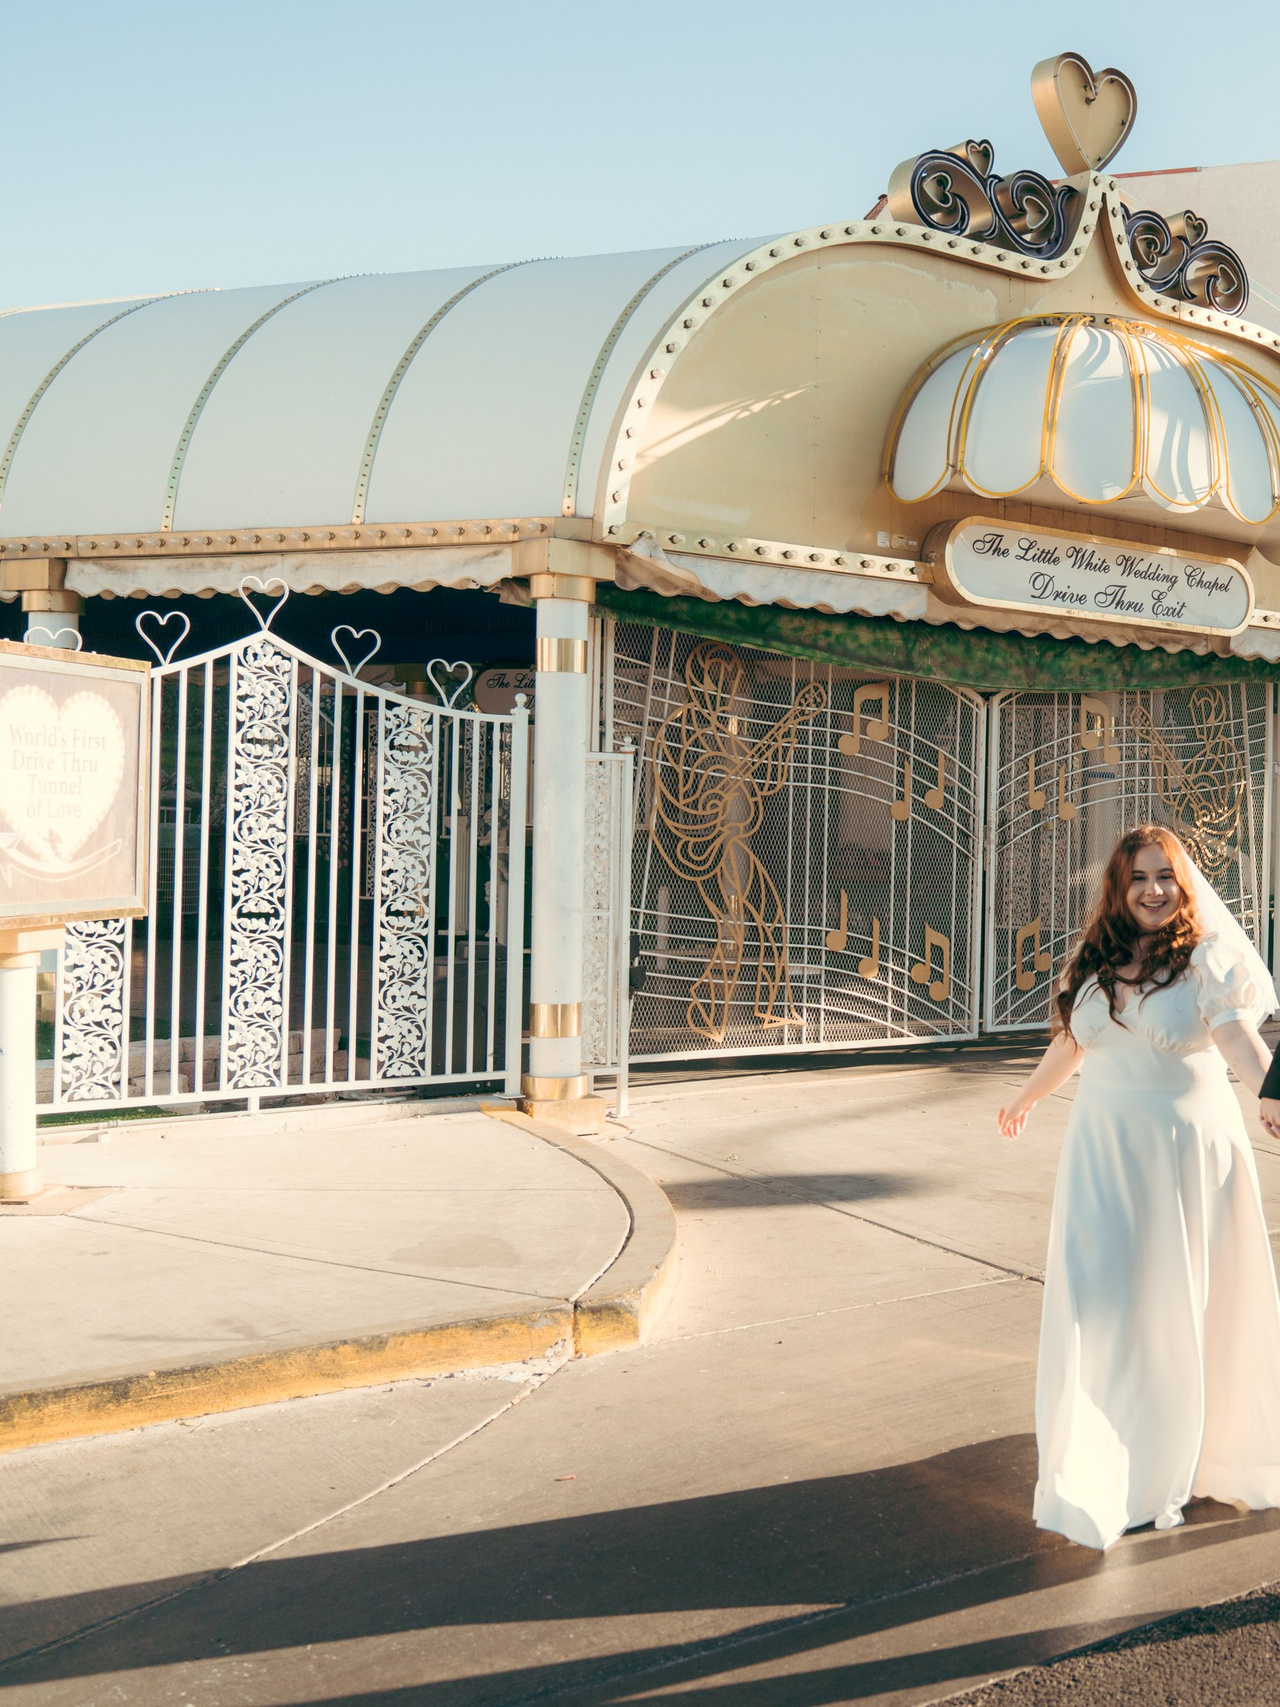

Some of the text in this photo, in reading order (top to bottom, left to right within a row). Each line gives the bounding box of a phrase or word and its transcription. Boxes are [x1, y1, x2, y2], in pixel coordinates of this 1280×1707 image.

[972, 532, 1234, 598] The Little White Wedding Chapel
[1028, 571, 1187, 619] Drive Thru Exit
[486, 673, 511, 690] The
[9, 724, 107, 750] World's First
[12, 749, 98, 773] Drive Thru
[27, 774, 82, 795] Tunnel
[26, 798, 81, 818] of Love
